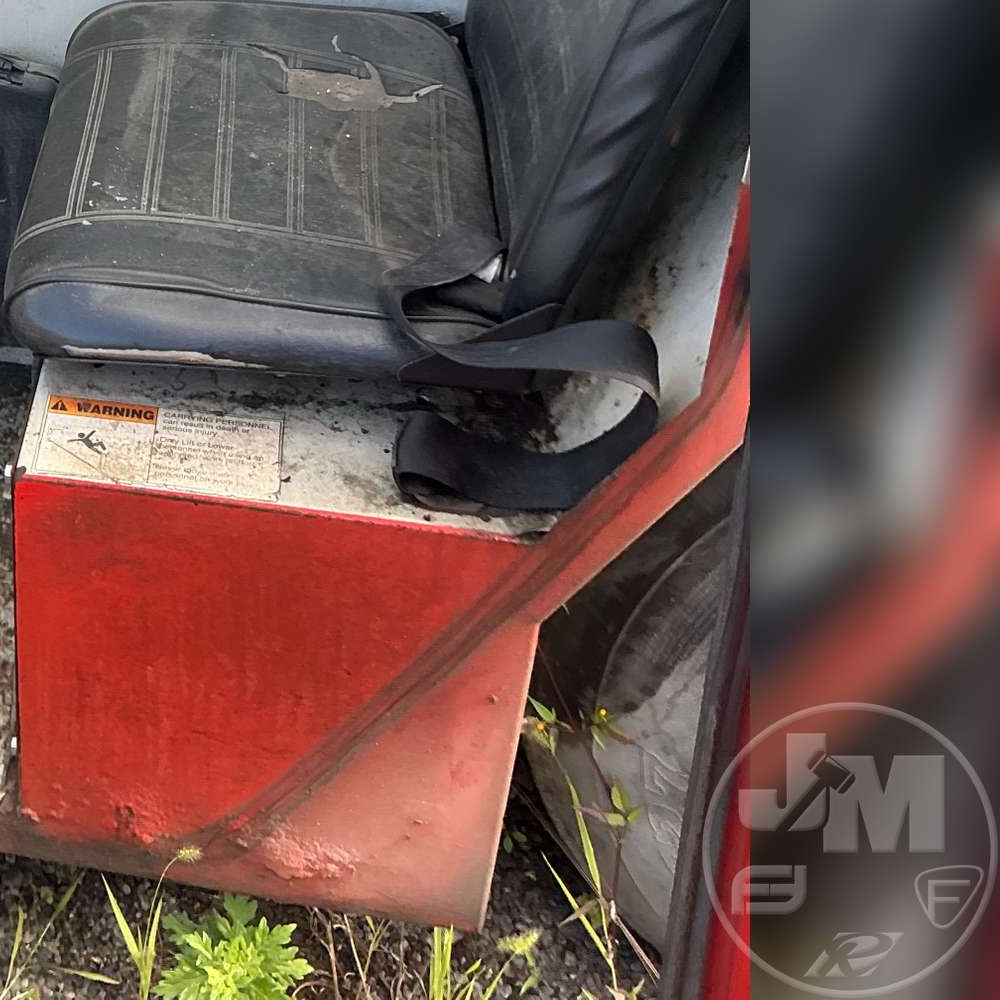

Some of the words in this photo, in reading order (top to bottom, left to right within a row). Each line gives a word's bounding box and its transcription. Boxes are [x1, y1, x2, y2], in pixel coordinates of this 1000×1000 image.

[76, 402, 155, 421] WARNING
[163, 411, 213, 423] CARRYING
[215, 416, 273, 431] PERSONNEL
[215, 425, 239, 433] death
